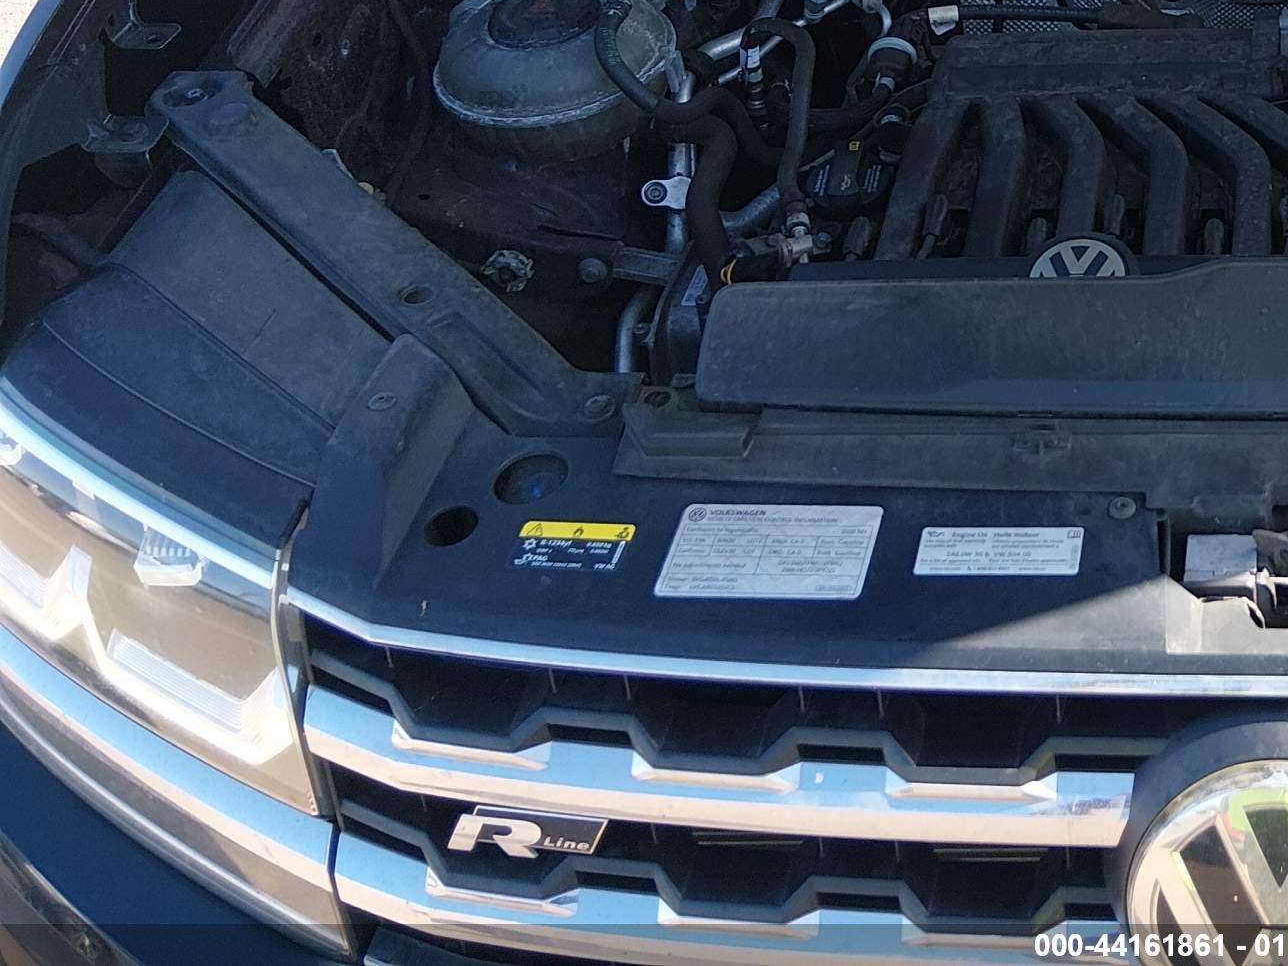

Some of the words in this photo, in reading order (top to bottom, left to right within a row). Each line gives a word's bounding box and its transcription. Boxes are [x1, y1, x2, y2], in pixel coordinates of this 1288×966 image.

[709, 509, 767, 517] VOLKSWAGEN
[447, 813, 543, 859] R
[543, 836, 591, 851] Line
